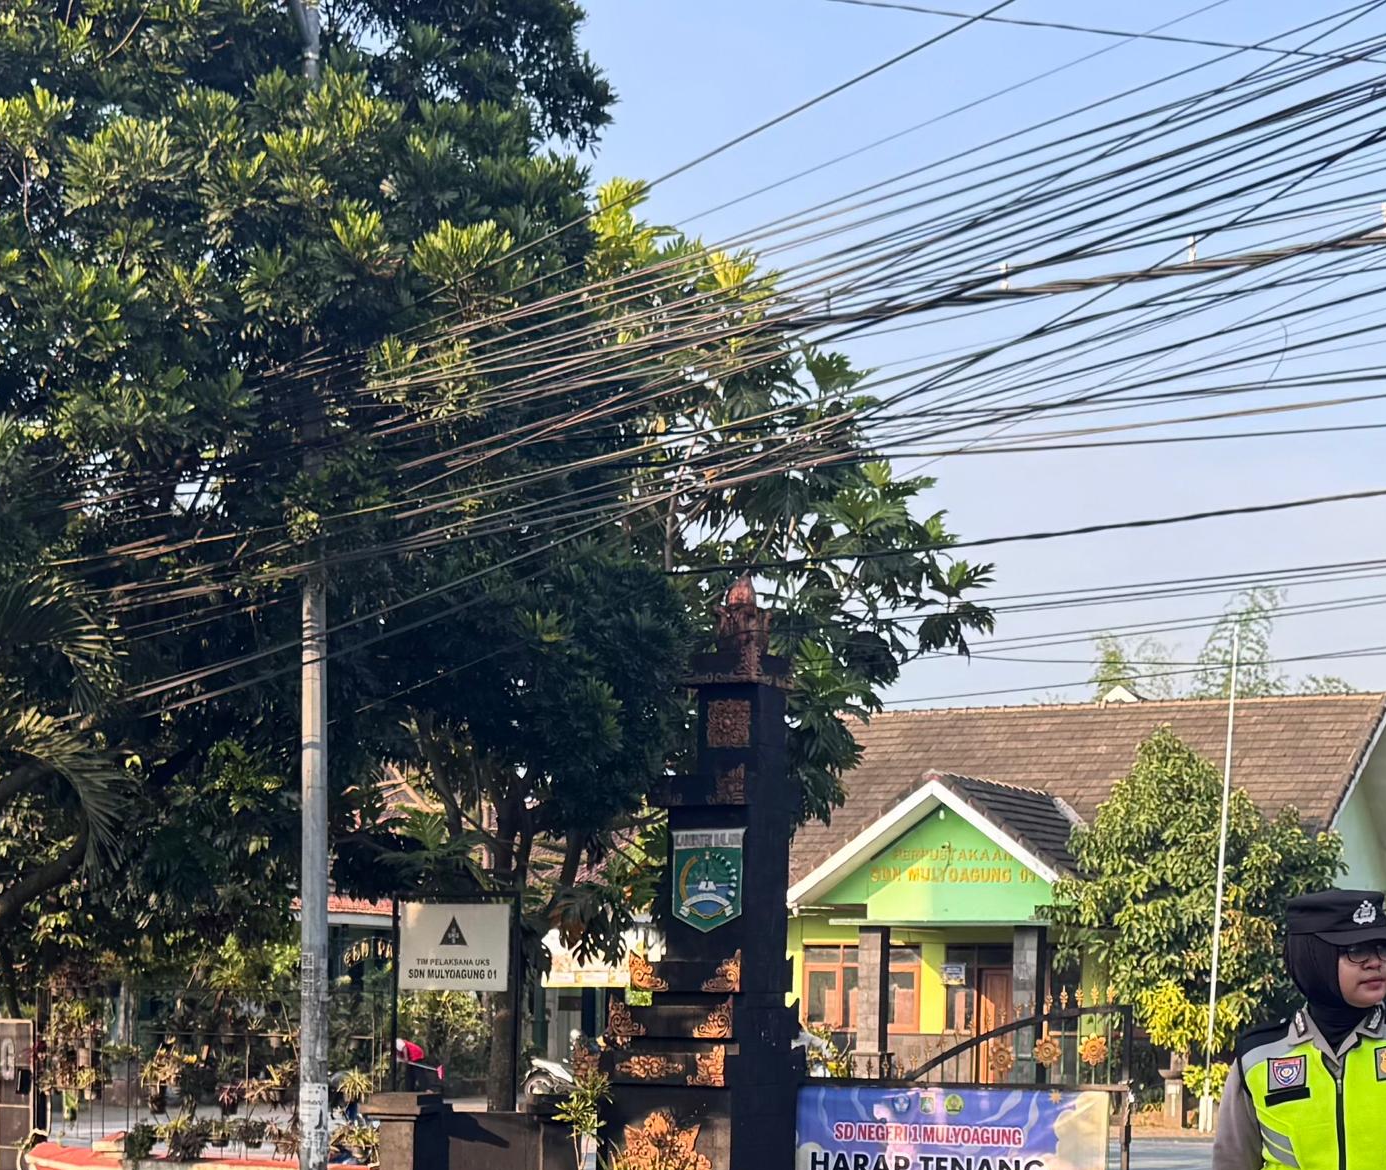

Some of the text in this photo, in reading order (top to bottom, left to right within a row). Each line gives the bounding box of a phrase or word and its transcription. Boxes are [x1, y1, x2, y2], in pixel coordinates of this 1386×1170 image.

[893, 848, 1013, 862] PERPUSTAKAAN
[870, 867, 901, 882] SDN
[908, 867, 1012, 883] MULYOAGUNG
[416, 958, 490, 967] TIM PELAKSANA UKS
[408, 969, 497, 980] SDN MULYOAGUNG 01
[834, 1122, 854, 1141] SD
[857, 1123, 908, 1143] NEGERI
[922, 1126, 1022, 1146] MULYOAGUNG
